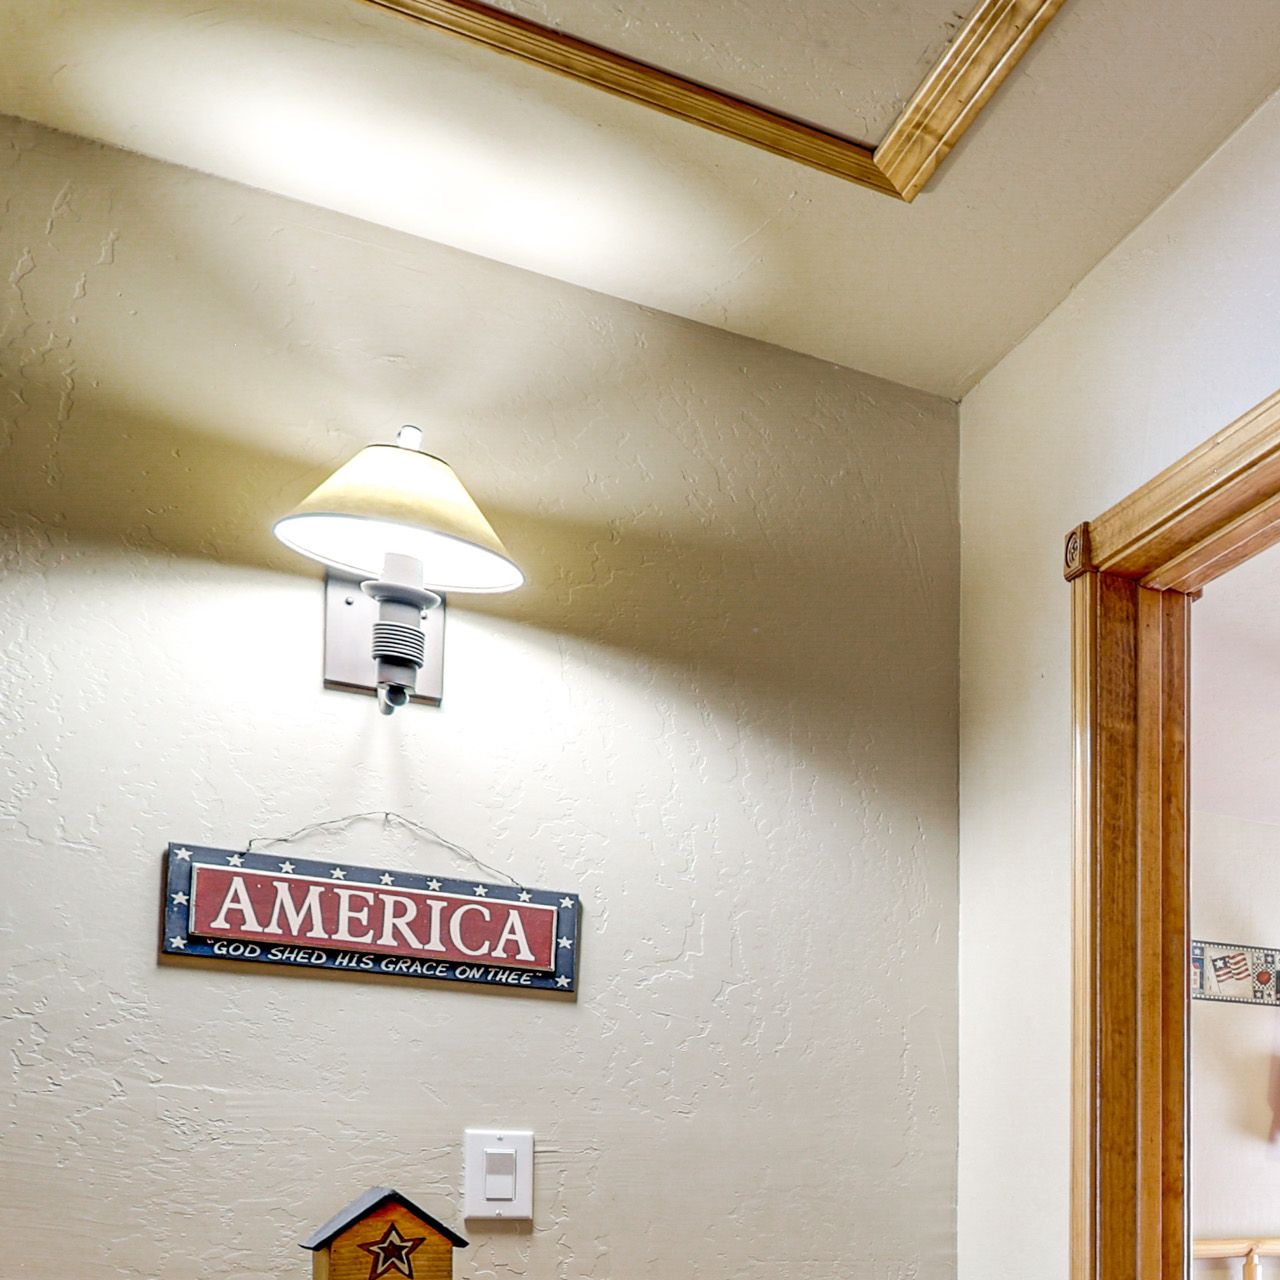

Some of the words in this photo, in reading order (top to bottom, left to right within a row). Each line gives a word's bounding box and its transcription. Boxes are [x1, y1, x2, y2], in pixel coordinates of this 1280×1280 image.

[209, 876, 535, 962] AMERICA
[269, 946, 327, 964] SHED
[335, 952, 374, 970] HIS
[381, 957, 448, 977] GRACE
[455, 965, 486, 980] ON
